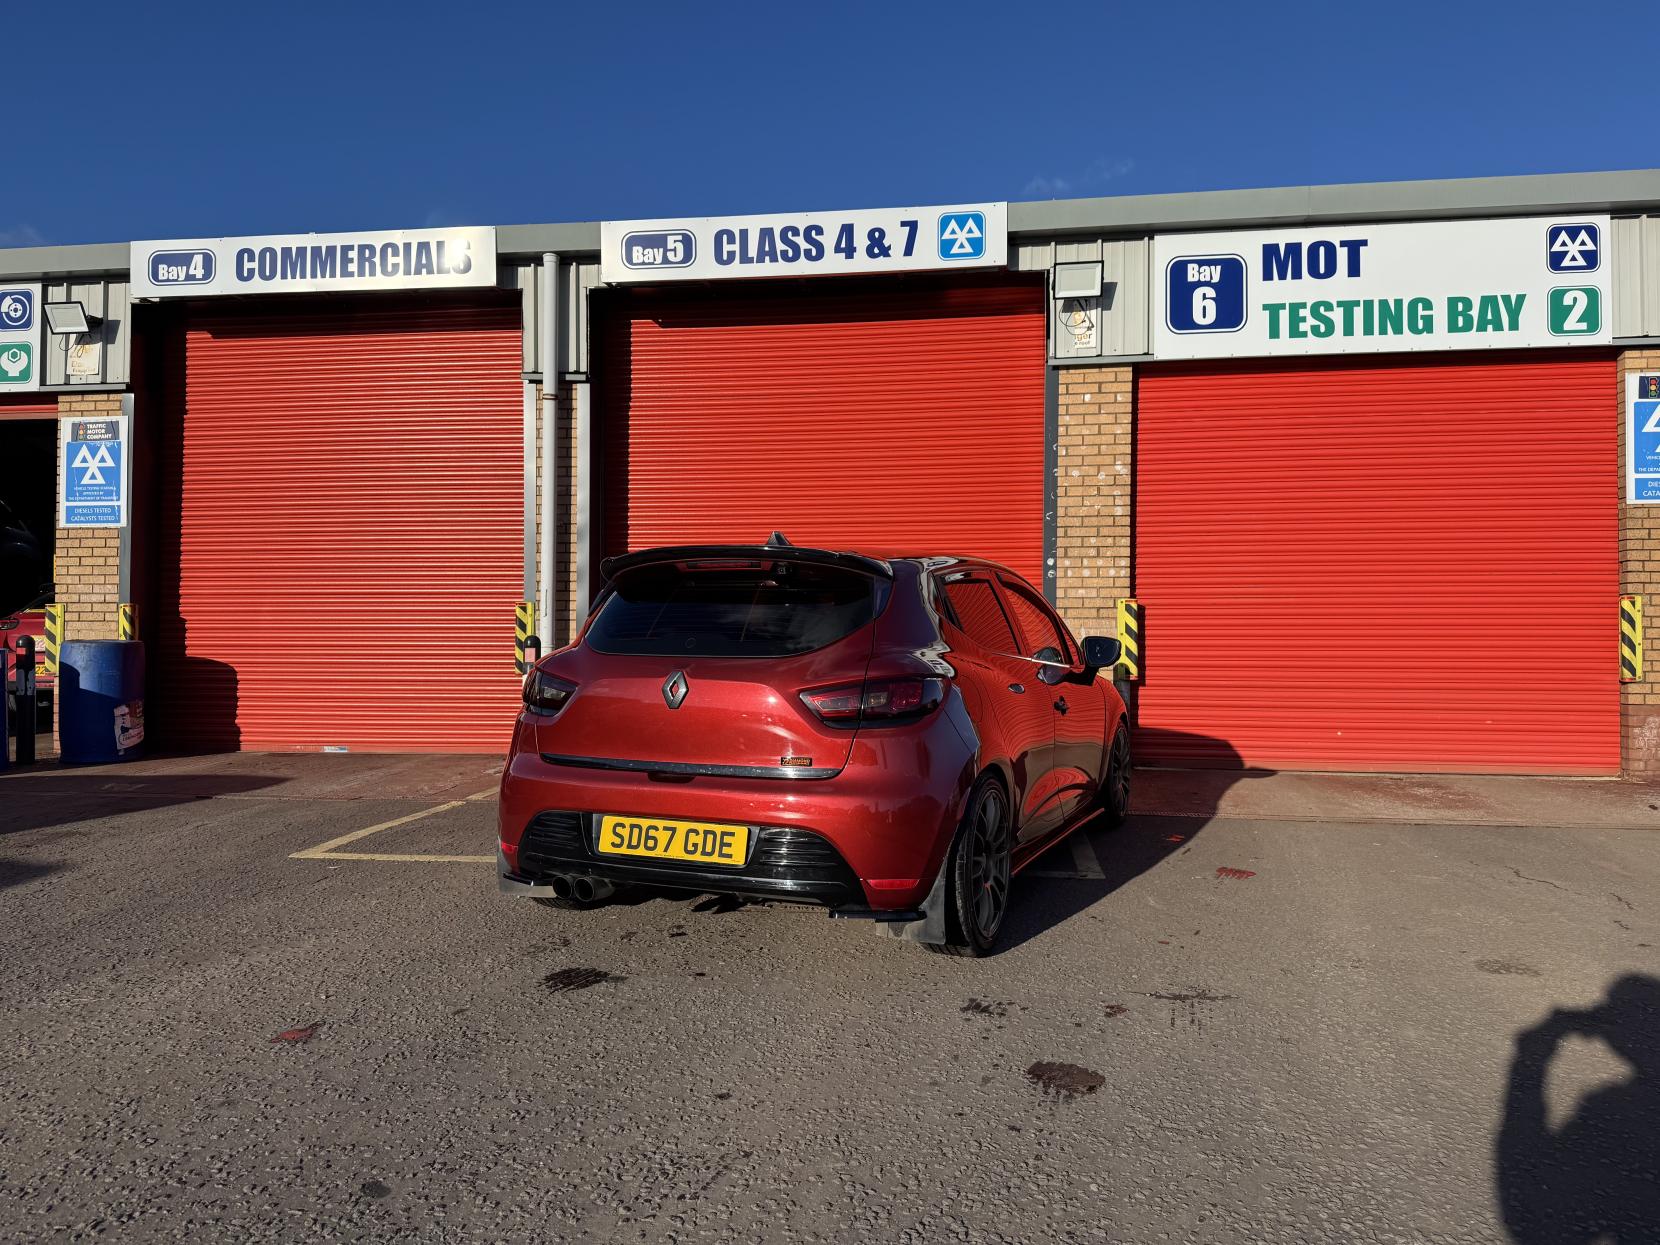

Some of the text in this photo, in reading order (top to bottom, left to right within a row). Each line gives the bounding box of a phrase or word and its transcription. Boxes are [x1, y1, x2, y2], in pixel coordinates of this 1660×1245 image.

[632, 234, 684, 265] Bay 5
[713, 219, 919, 266] CLASS 4 & 7
[1261, 239, 1369, 282] MOT
[158, 253, 205, 281] Bay 4
[1187, 262, 1222, 284] Bay
[1191, 286, 1218, 326] 6
[1261, 293, 1528, 340] TESTING BAY
[1560, 290, 1590, 332] 2
[610, 822, 736, 859] SD67 GDE
